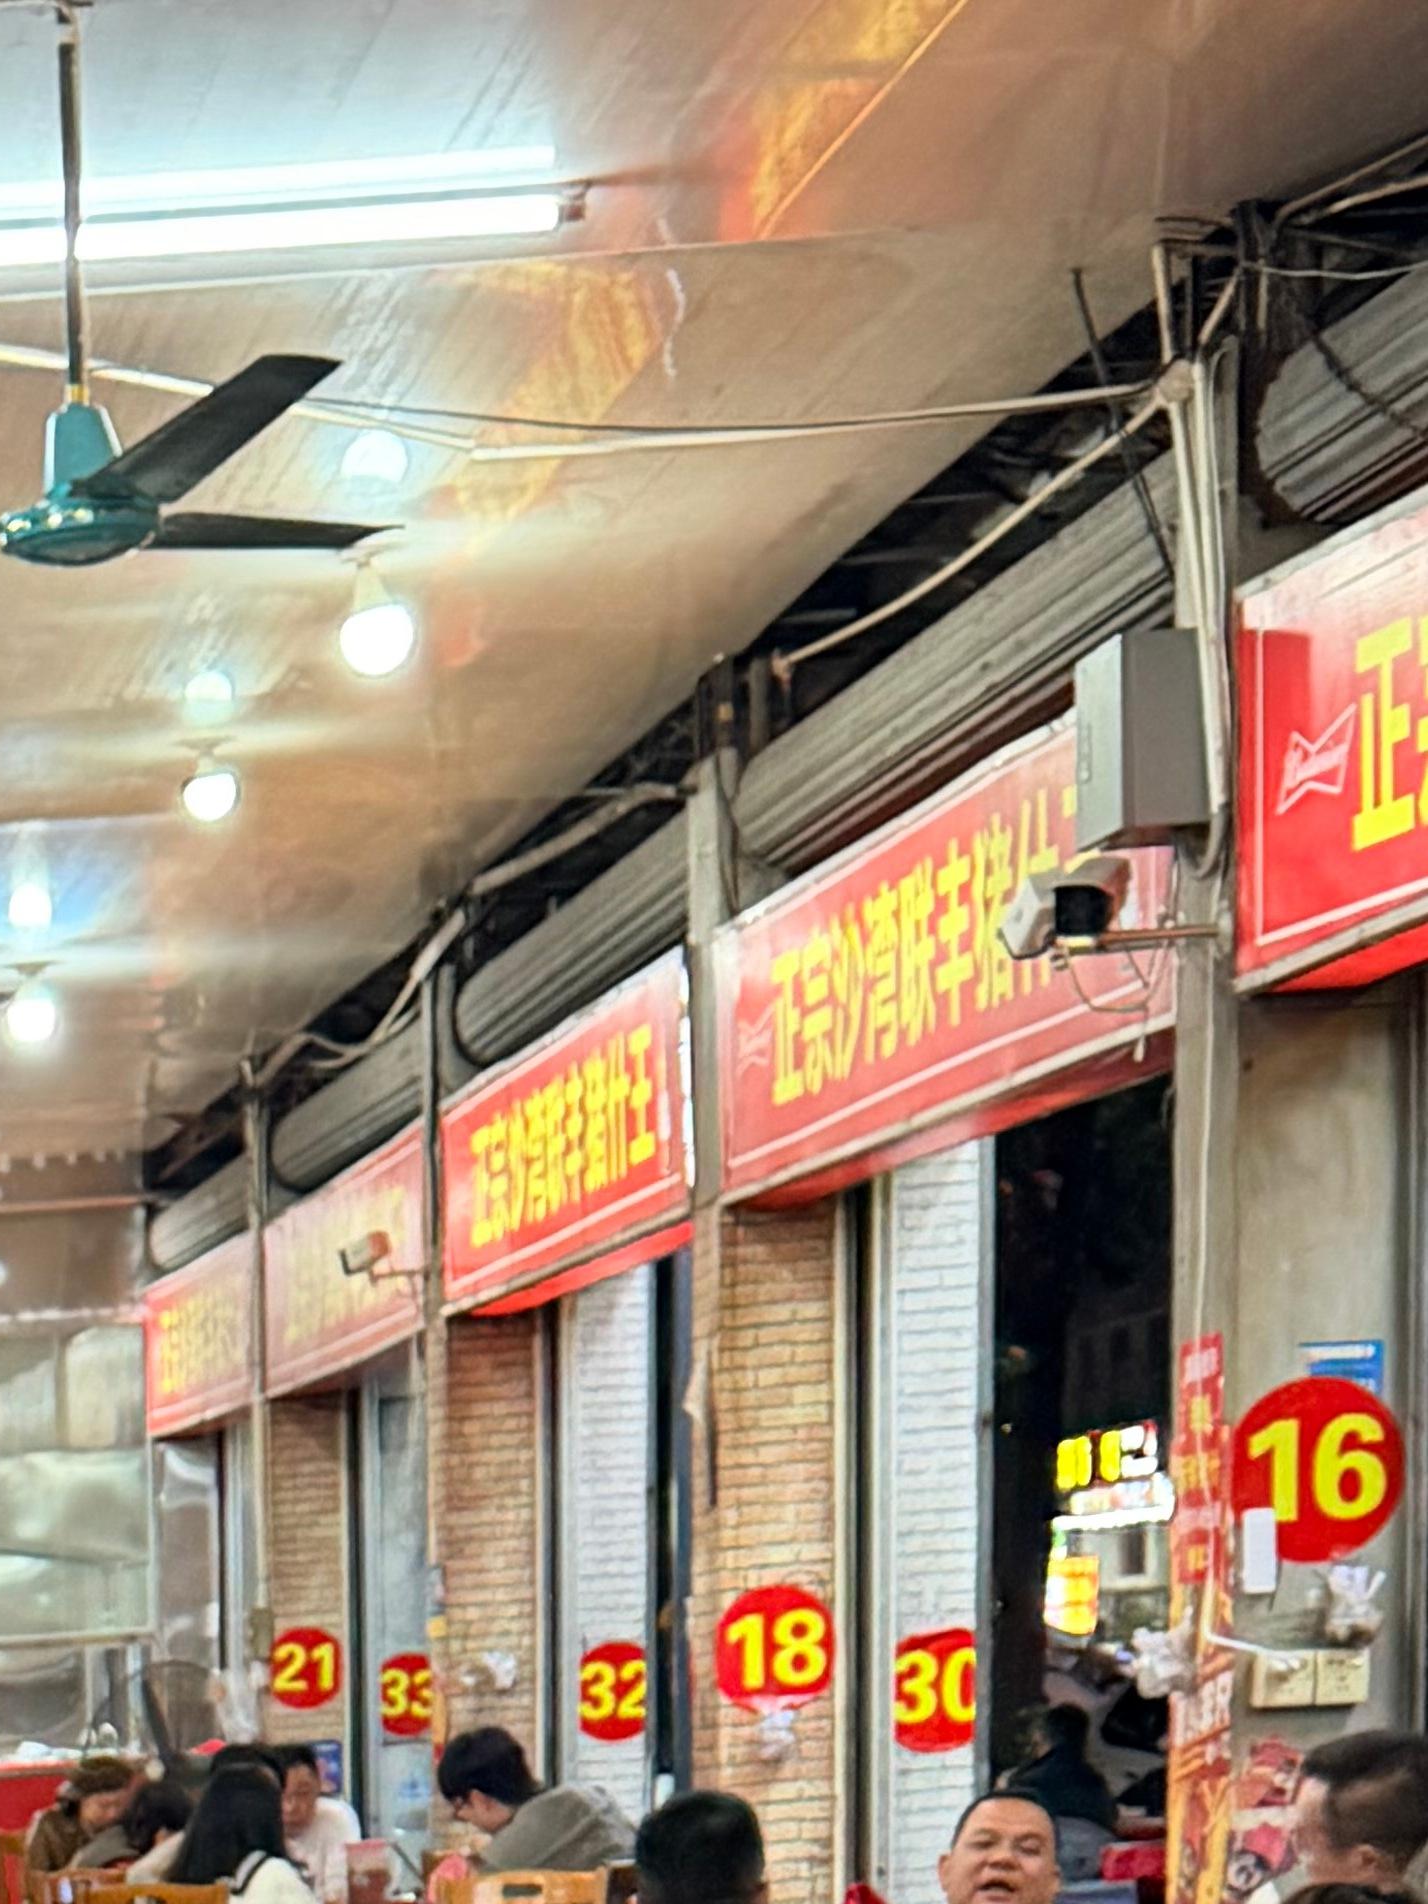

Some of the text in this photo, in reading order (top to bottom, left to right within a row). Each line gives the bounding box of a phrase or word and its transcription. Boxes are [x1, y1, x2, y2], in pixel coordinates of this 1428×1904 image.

[1351, 613, 1428, 853] 正
[1249, 1413, 1387, 1523] 16
[273, 1642, 334, 1692] 21
[727, 1608, 826, 1691] 18
[894, 1648, 976, 1723] 30
[379, 1668, 435, 1717] 33
[577, 1659, 647, 1720] 32
